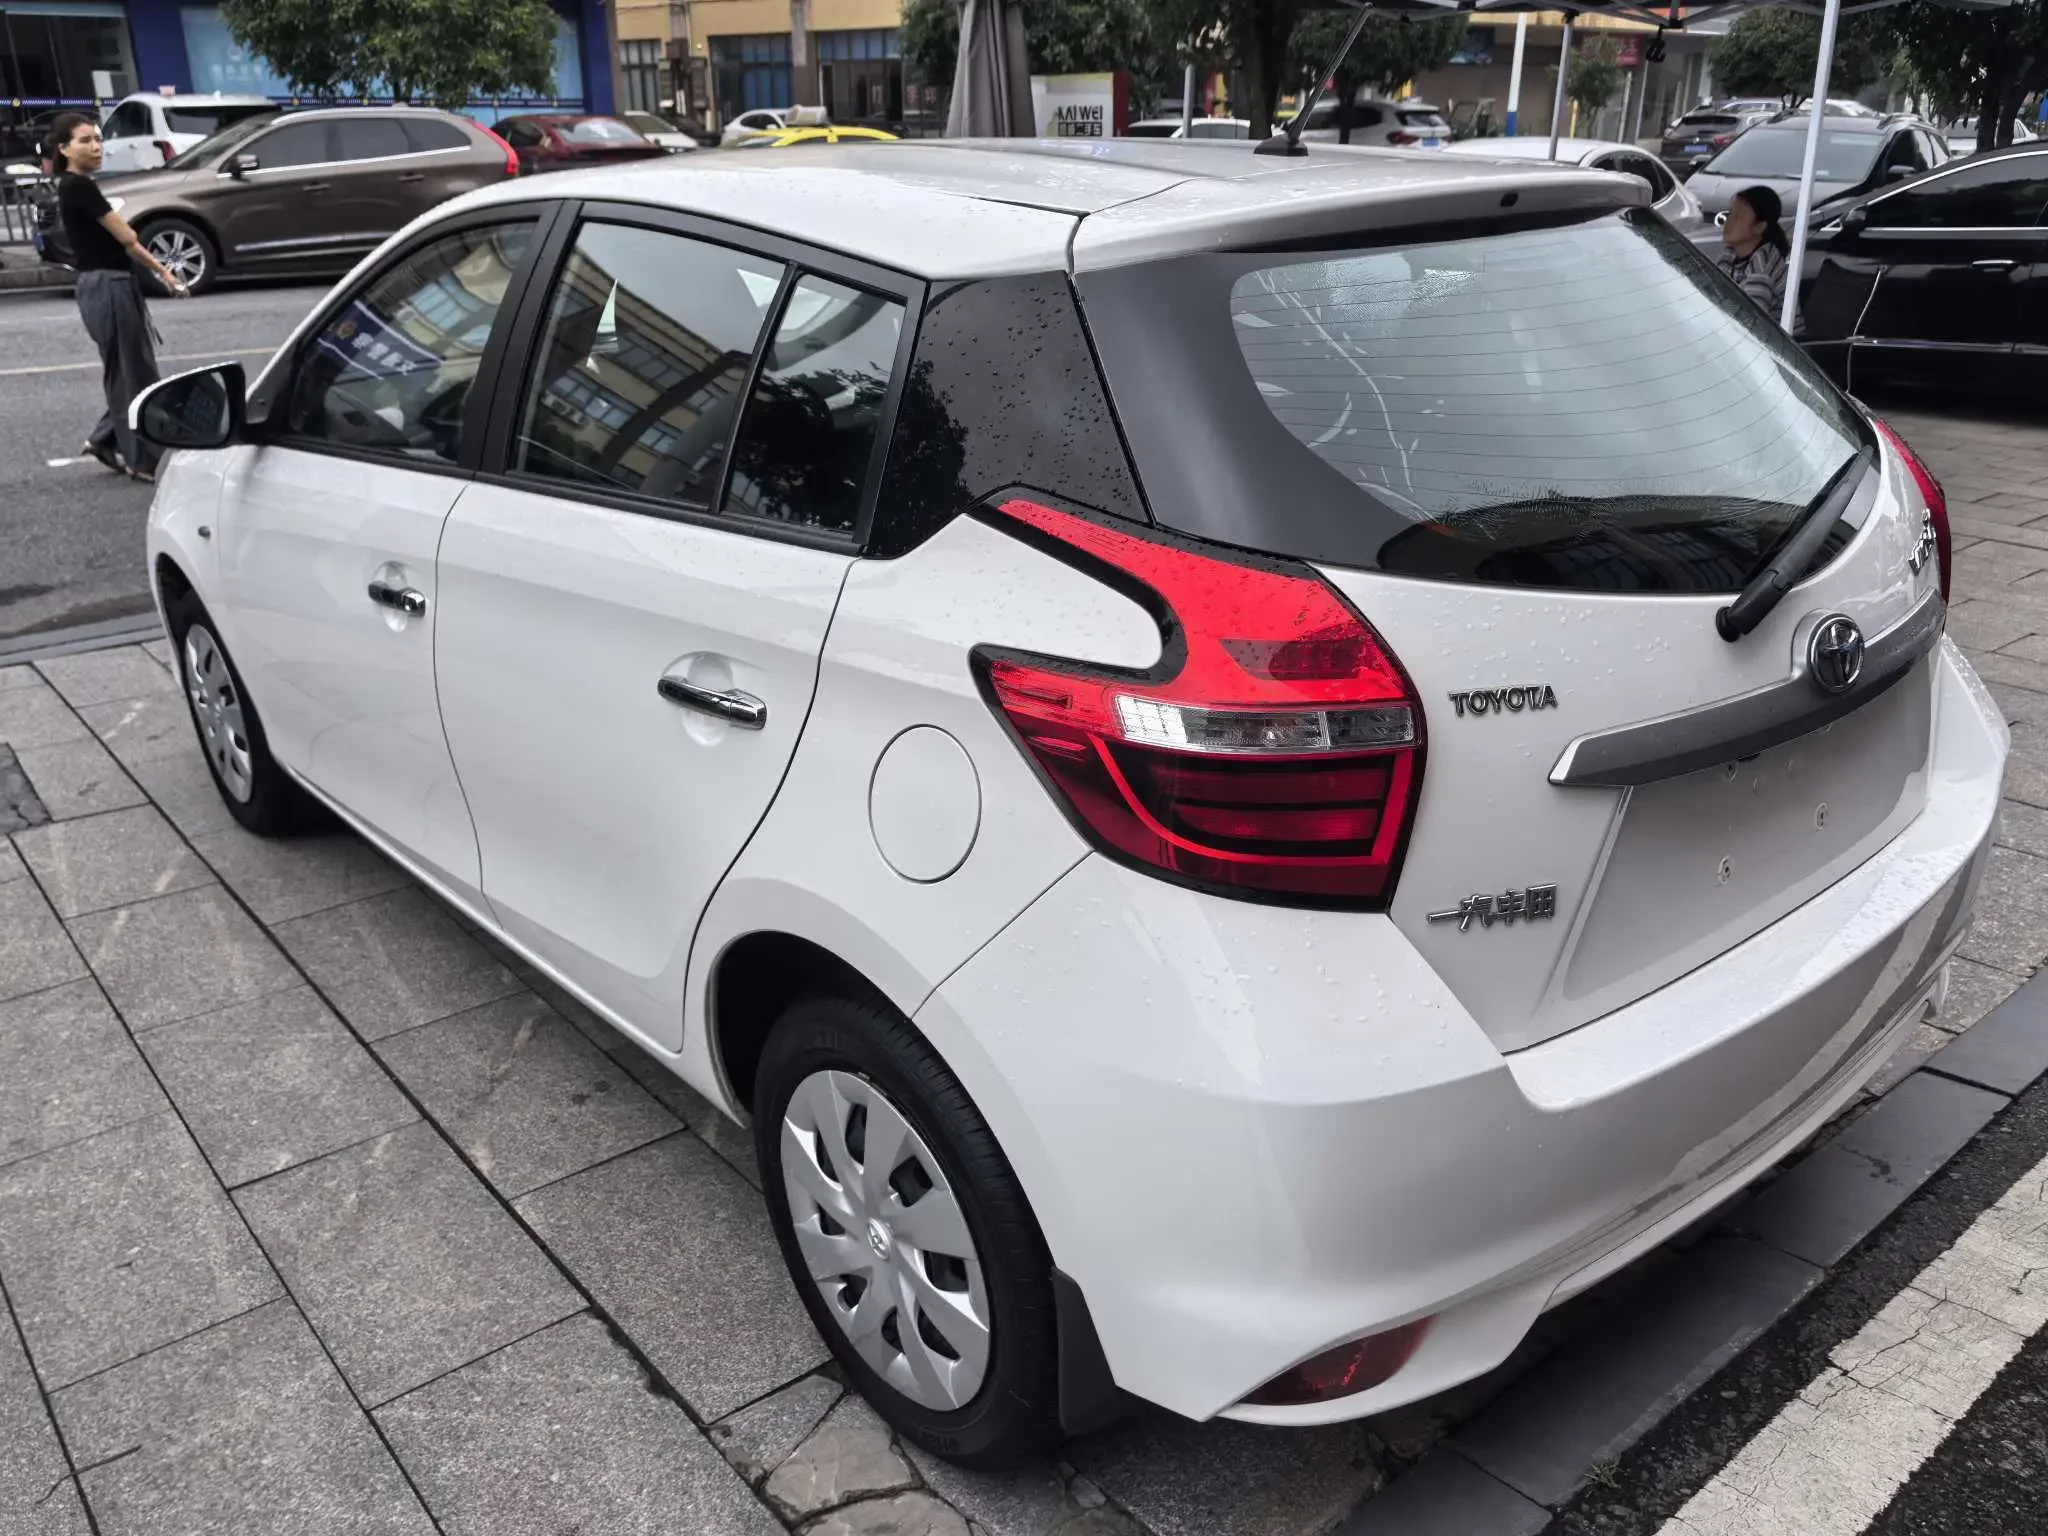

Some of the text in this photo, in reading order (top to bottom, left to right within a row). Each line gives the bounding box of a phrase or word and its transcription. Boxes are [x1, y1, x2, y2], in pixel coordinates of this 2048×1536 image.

[1079, 104, 1103, 120] WEI
[1449, 685, 1558, 717] TOYOTA
[1427, 884, 1557, 931] 一汽丰田
